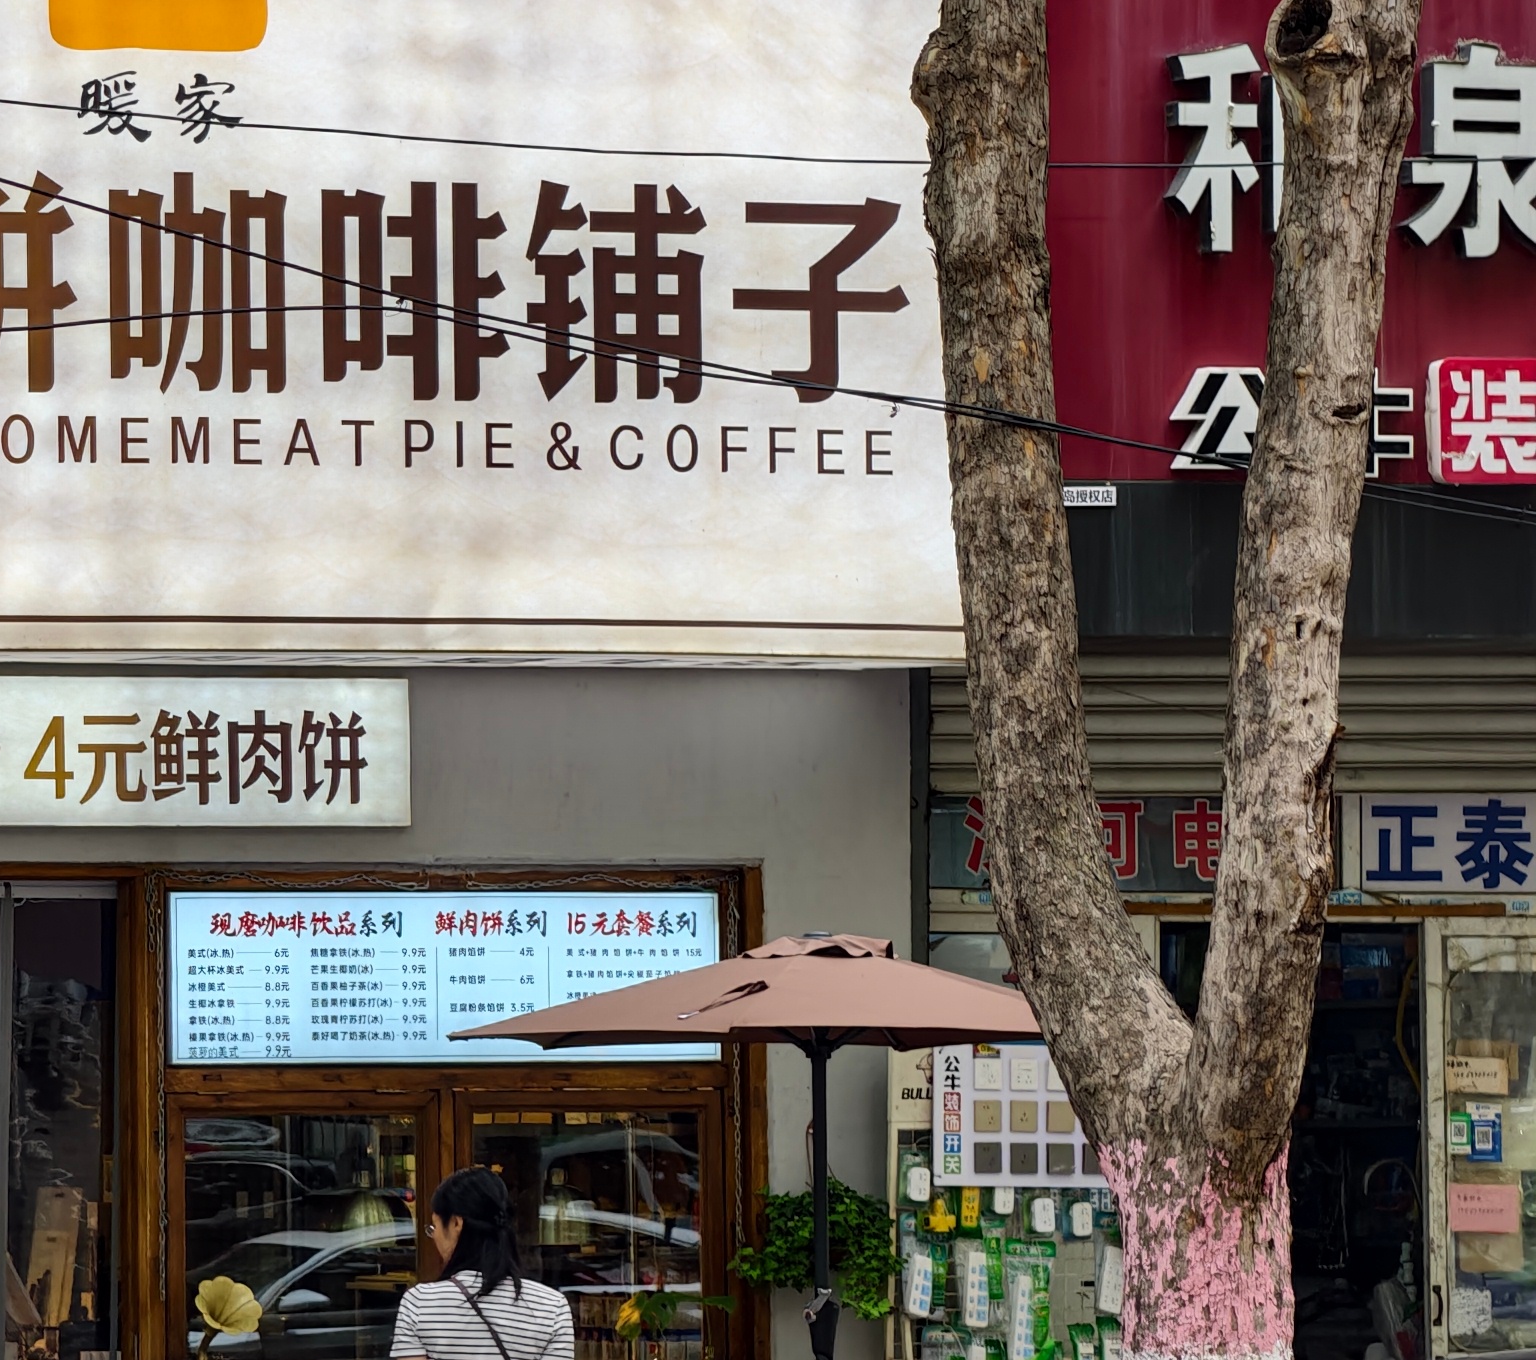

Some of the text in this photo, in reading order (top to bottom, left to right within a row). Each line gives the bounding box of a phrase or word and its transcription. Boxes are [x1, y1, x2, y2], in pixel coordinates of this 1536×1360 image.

[77, 70, 244, 144] 暖家
[1367, 798, 1535, 890] 正泰
[209, 910, 403, 938] 现磨咖啡饮品系列
[435, 909, 547, 938] 鲜肉饼系列
[567, 909, 697, 938] 15元套餐系列
[274, 948, 290, 958] 6元
[401, 947, 427, 958] 9.9元
[448, 947, 535, 957] 猪肉馅饼 4元
[686, 948, 703, 957] 15元
[187, 965, 290, 975] 超大杯冰美式 9.9元
[401, 964, 427, 975] 9.9元
[449, 975, 535, 984] 牛肉馅饼 6元
[264, 981, 290, 992] 8.8元
[401, 981, 427, 991] 9.9元
[265, 998, 290, 1008] 9.9元
[401, 998, 427, 1008] 9.9元
[510, 1003, 535, 1013] 3.5元
[265, 1015, 290, 1025] 8.8元
[402, 1014, 427, 1025] 9.9元
[265, 1032, 291, 1042] 9.9元
[402, 1031, 427, 1041] 9.9元
[265, 1045, 292, 1058] 9.9元
[901, 1087, 932, 1100] BULL
[944, 1055, 961, 1174] 公牛装饰开关
